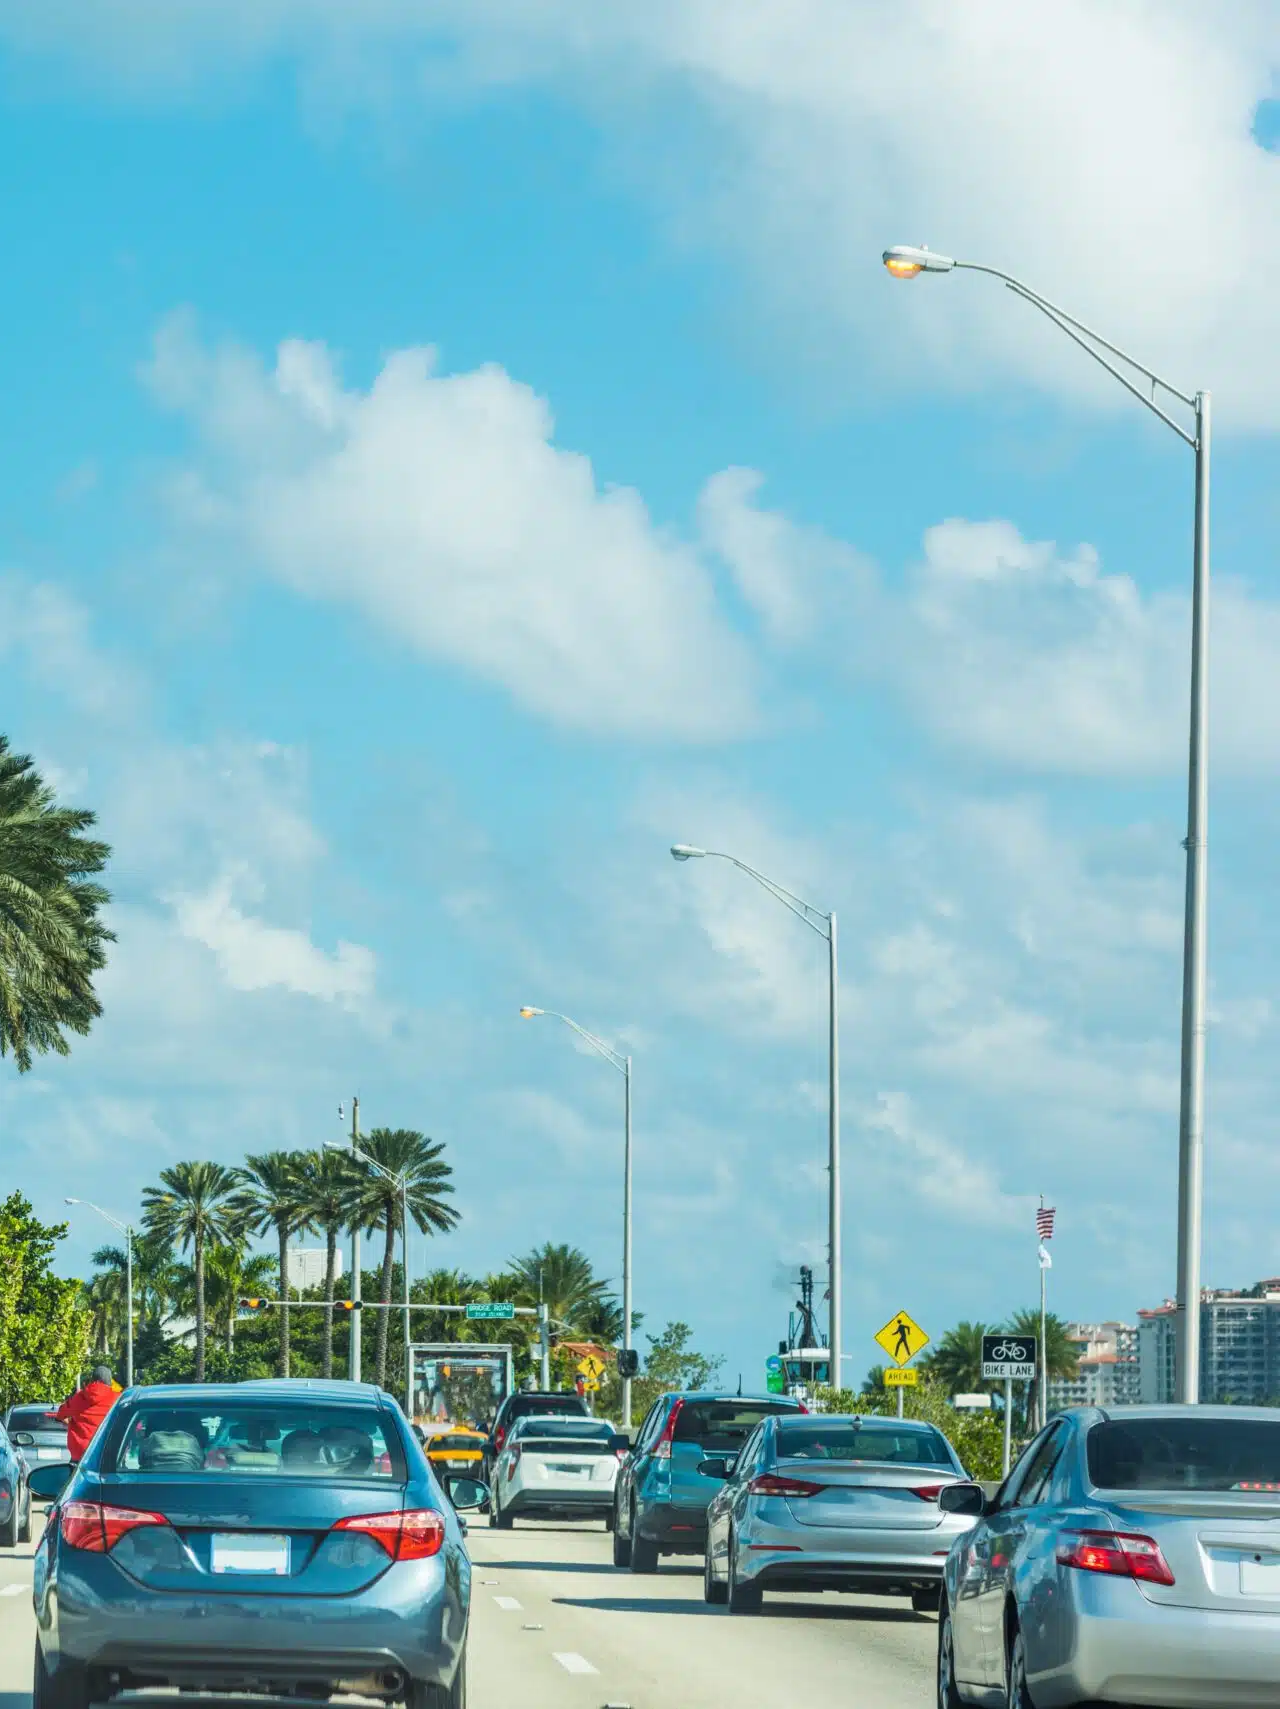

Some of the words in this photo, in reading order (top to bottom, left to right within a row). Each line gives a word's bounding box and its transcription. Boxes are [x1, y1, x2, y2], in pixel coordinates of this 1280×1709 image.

[493, 1303, 512, 1311] ROAD
[984, 1364, 1005, 1376] BIKE
[1010, 1364, 1033, 1376] LANE
[888, 1372, 914, 1381] AHEAD
